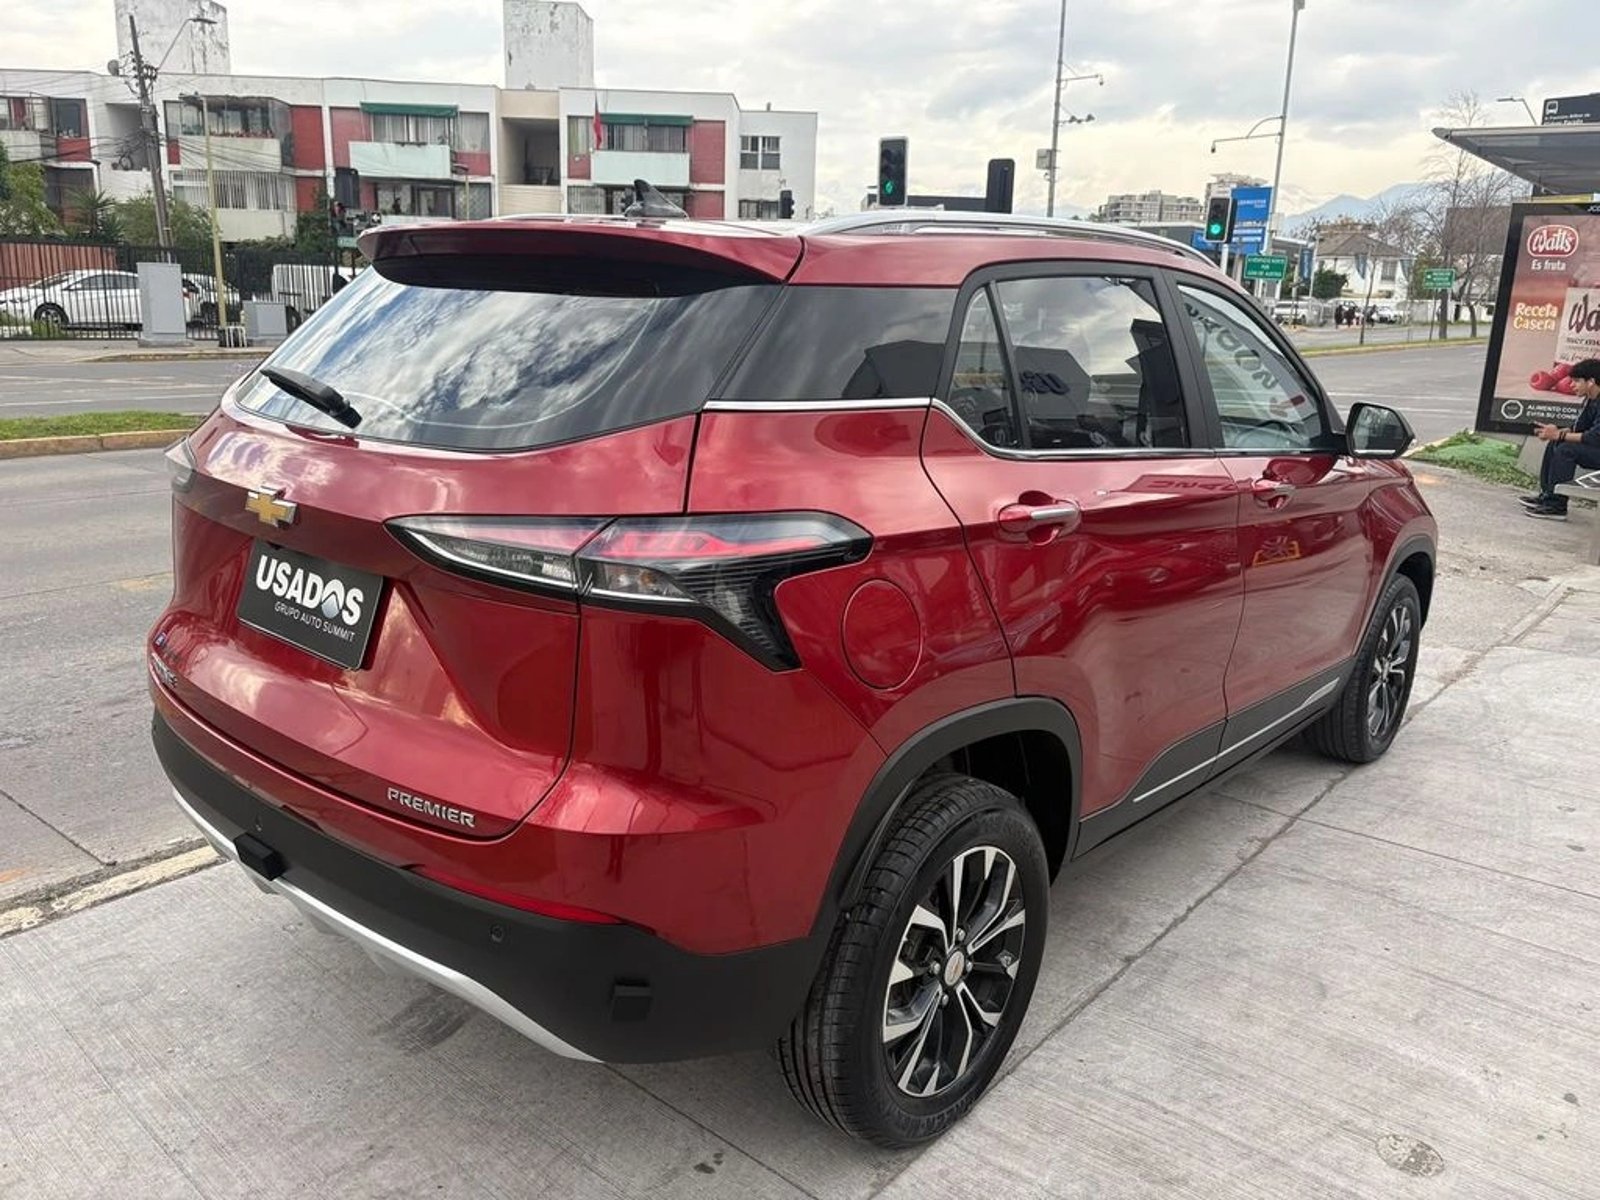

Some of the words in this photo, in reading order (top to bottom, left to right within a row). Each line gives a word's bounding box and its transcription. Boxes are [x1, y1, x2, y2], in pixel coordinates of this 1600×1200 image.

[1531, 259, 1542, 270] Es
[1543, 259, 1566, 271] fruta
[1513, 316, 1556, 331] Casera
[1515, 302, 1558, 318] Receta
[256, 555, 364, 626] USADOS
[274, 601, 300, 620] GRUPO
[300, 612, 322, 629] AUTO
[323, 621, 355, 642] SUMMIT
[387, 787, 475, 828] PREMIER
